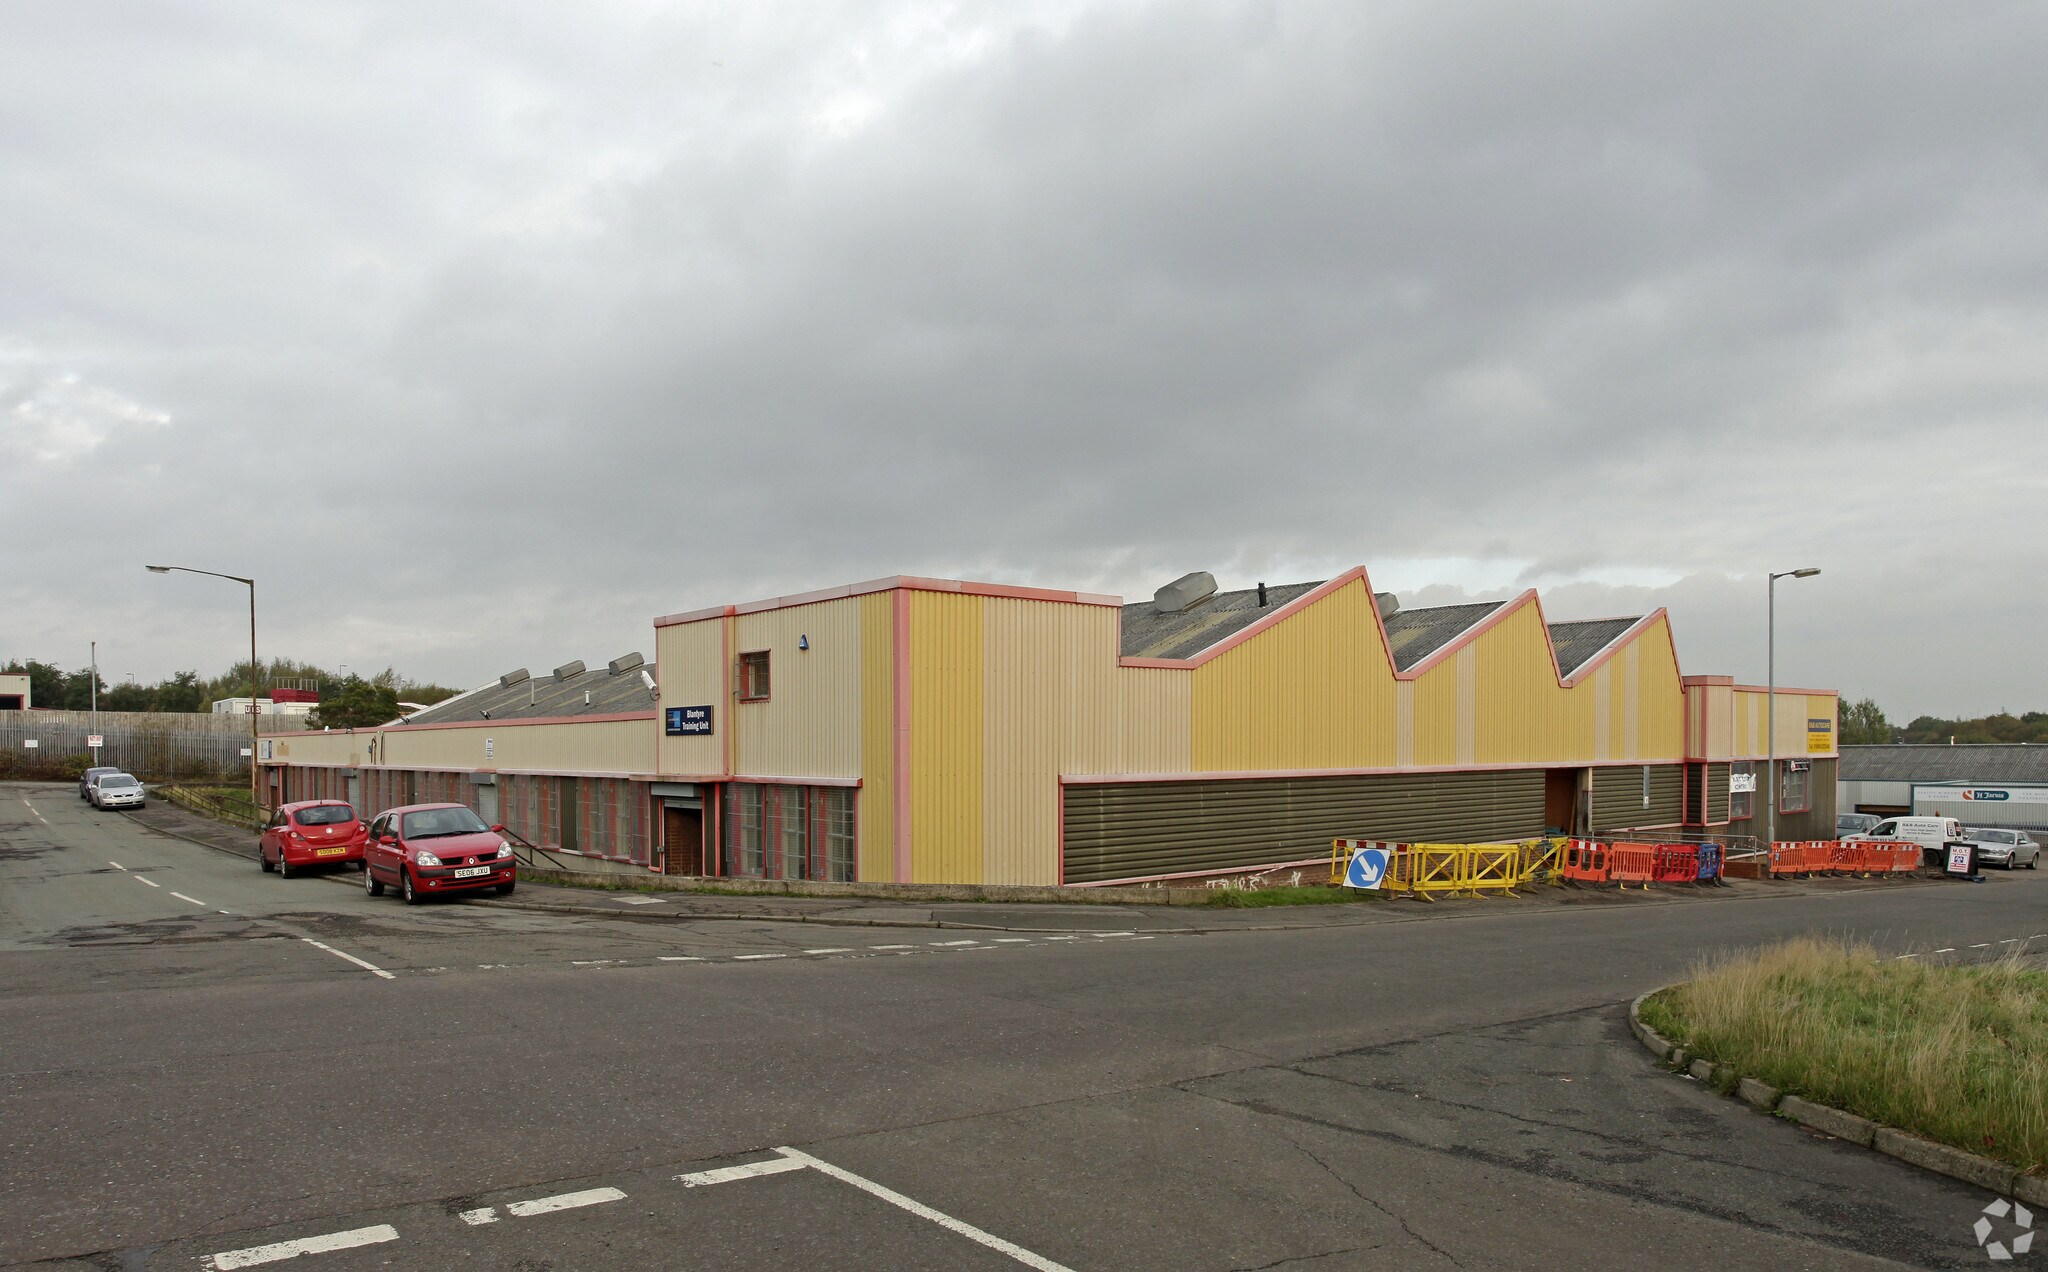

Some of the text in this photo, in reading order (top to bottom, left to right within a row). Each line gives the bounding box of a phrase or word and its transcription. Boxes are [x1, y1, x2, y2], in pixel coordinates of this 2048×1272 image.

[687, 710, 704, 719] Blantyre
[682, 721, 709, 731] Training Unit
